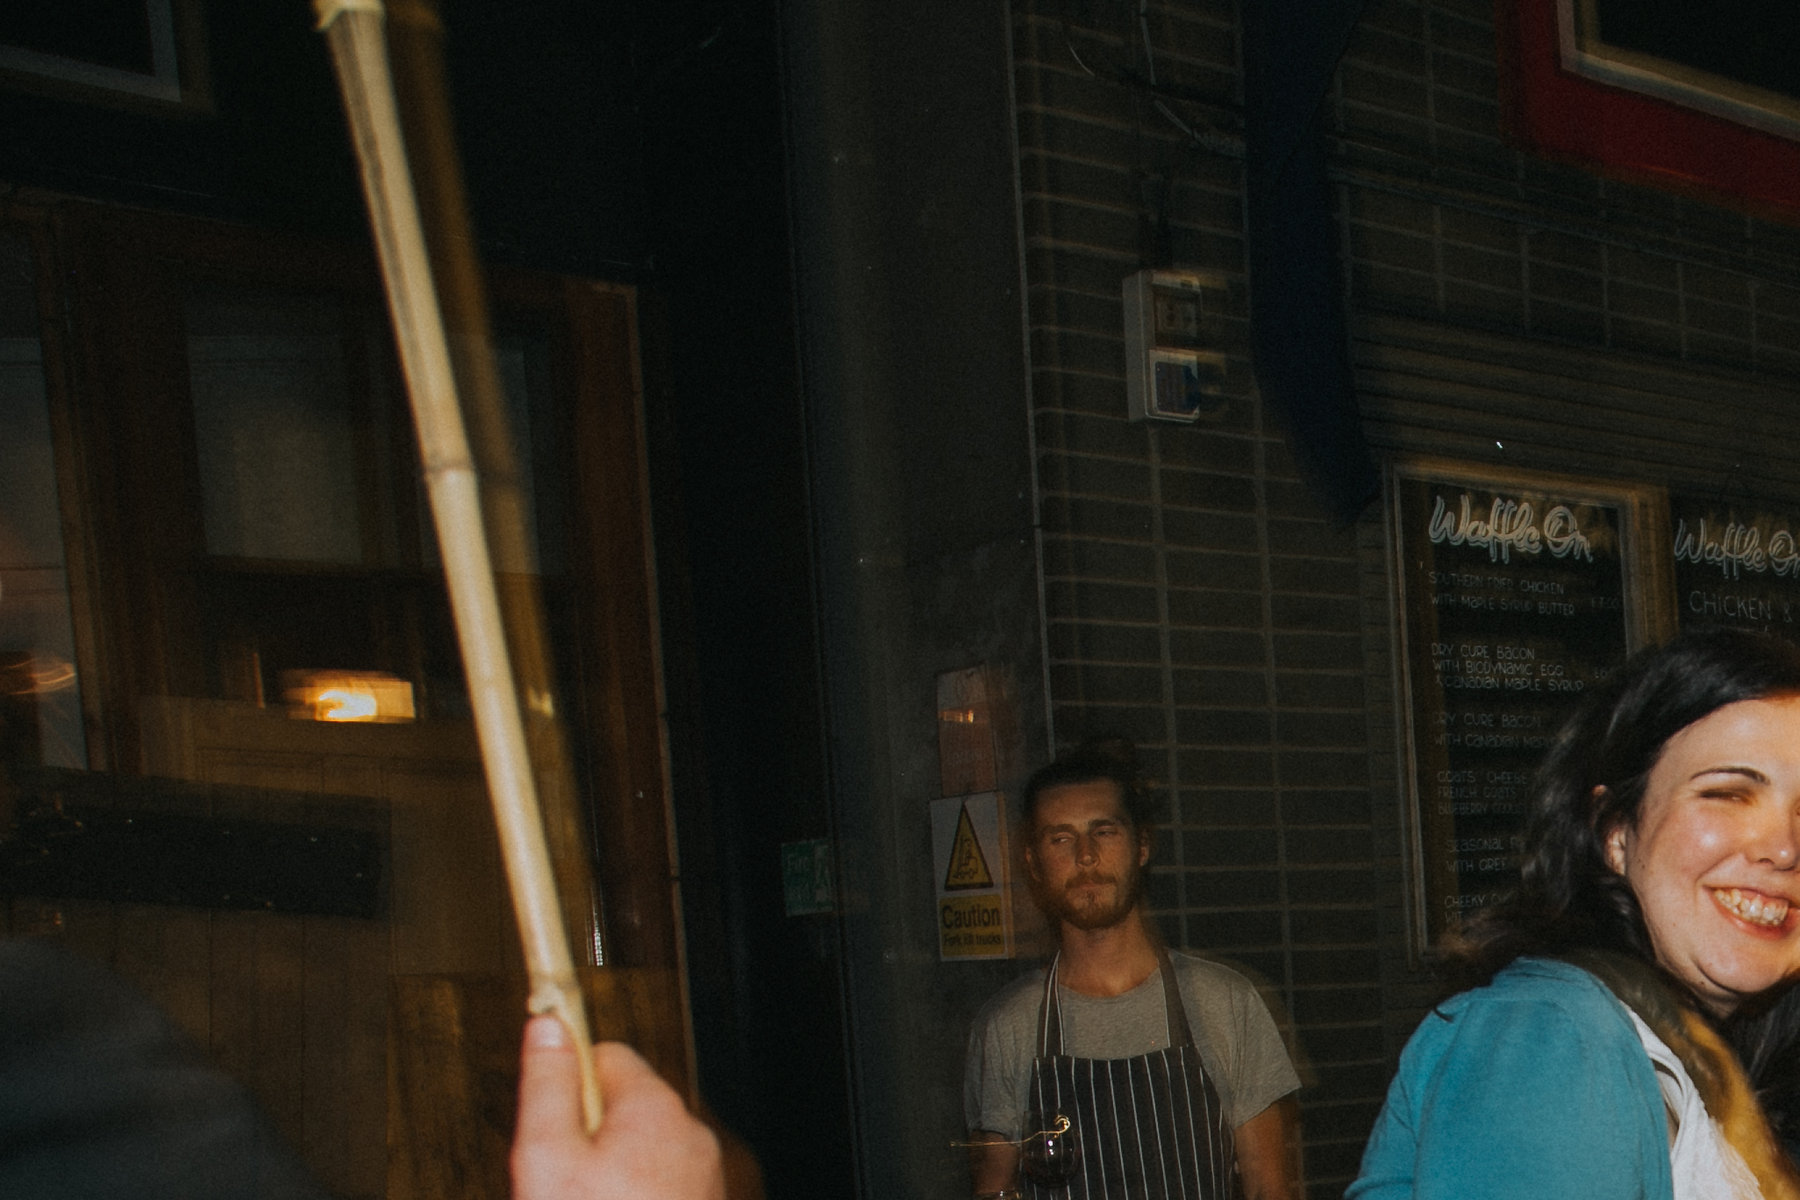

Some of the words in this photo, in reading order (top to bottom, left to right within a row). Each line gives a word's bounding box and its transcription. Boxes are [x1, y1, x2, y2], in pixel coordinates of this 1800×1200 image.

[1429, 494, 1542, 565] Waffle
[1544, 505, 1593, 563] On
[1674, 517, 1767, 581] Waffle
[1520, 579, 1564, 595] CHICKEN
[1429, 592, 1457, 606] WITH
[1499, 597, 1533, 612] SYRUP
[1538, 601, 1575, 616] BUTTER
[1688, 590, 1772, 621] CHICKEN
[1783, 602, 1793, 623] &
[1430, 642, 1454, 656] DRY
[1460, 643, 1490, 659] CURE
[1432, 658, 1460, 672] WITH
[1540, 663, 1564, 677] EGG
[1548, 678, 1584, 692] SYRUP
[1432, 711, 1456, 725] DRY
[1464, 712, 1494, 727] CURE
[943, 904, 1000, 929] Caution
